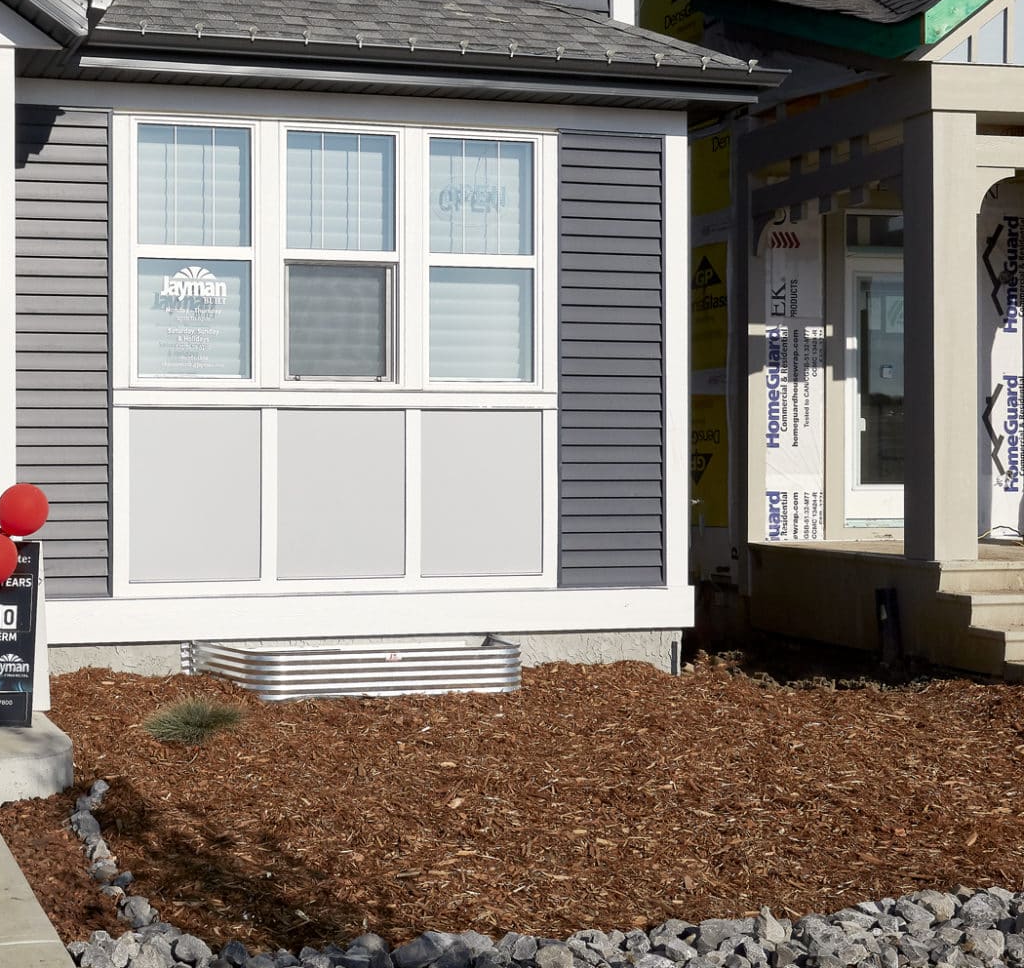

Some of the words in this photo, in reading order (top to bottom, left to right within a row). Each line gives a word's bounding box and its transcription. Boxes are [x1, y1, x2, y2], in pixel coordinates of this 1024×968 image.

[160, 275, 227, 301] Jayman
[1003, 216, 1019, 334] HomeGuard
[765, 329, 780, 449] HomeGuard
[780, 328, 788, 375] Residential
[791, 328, 800, 448] homeguardhousewrap.com
[780, 385, 788, 433] Commercial
[1003, 374, 1019, 493] HomeGuard
[780, 491, 788, 536] Residential
